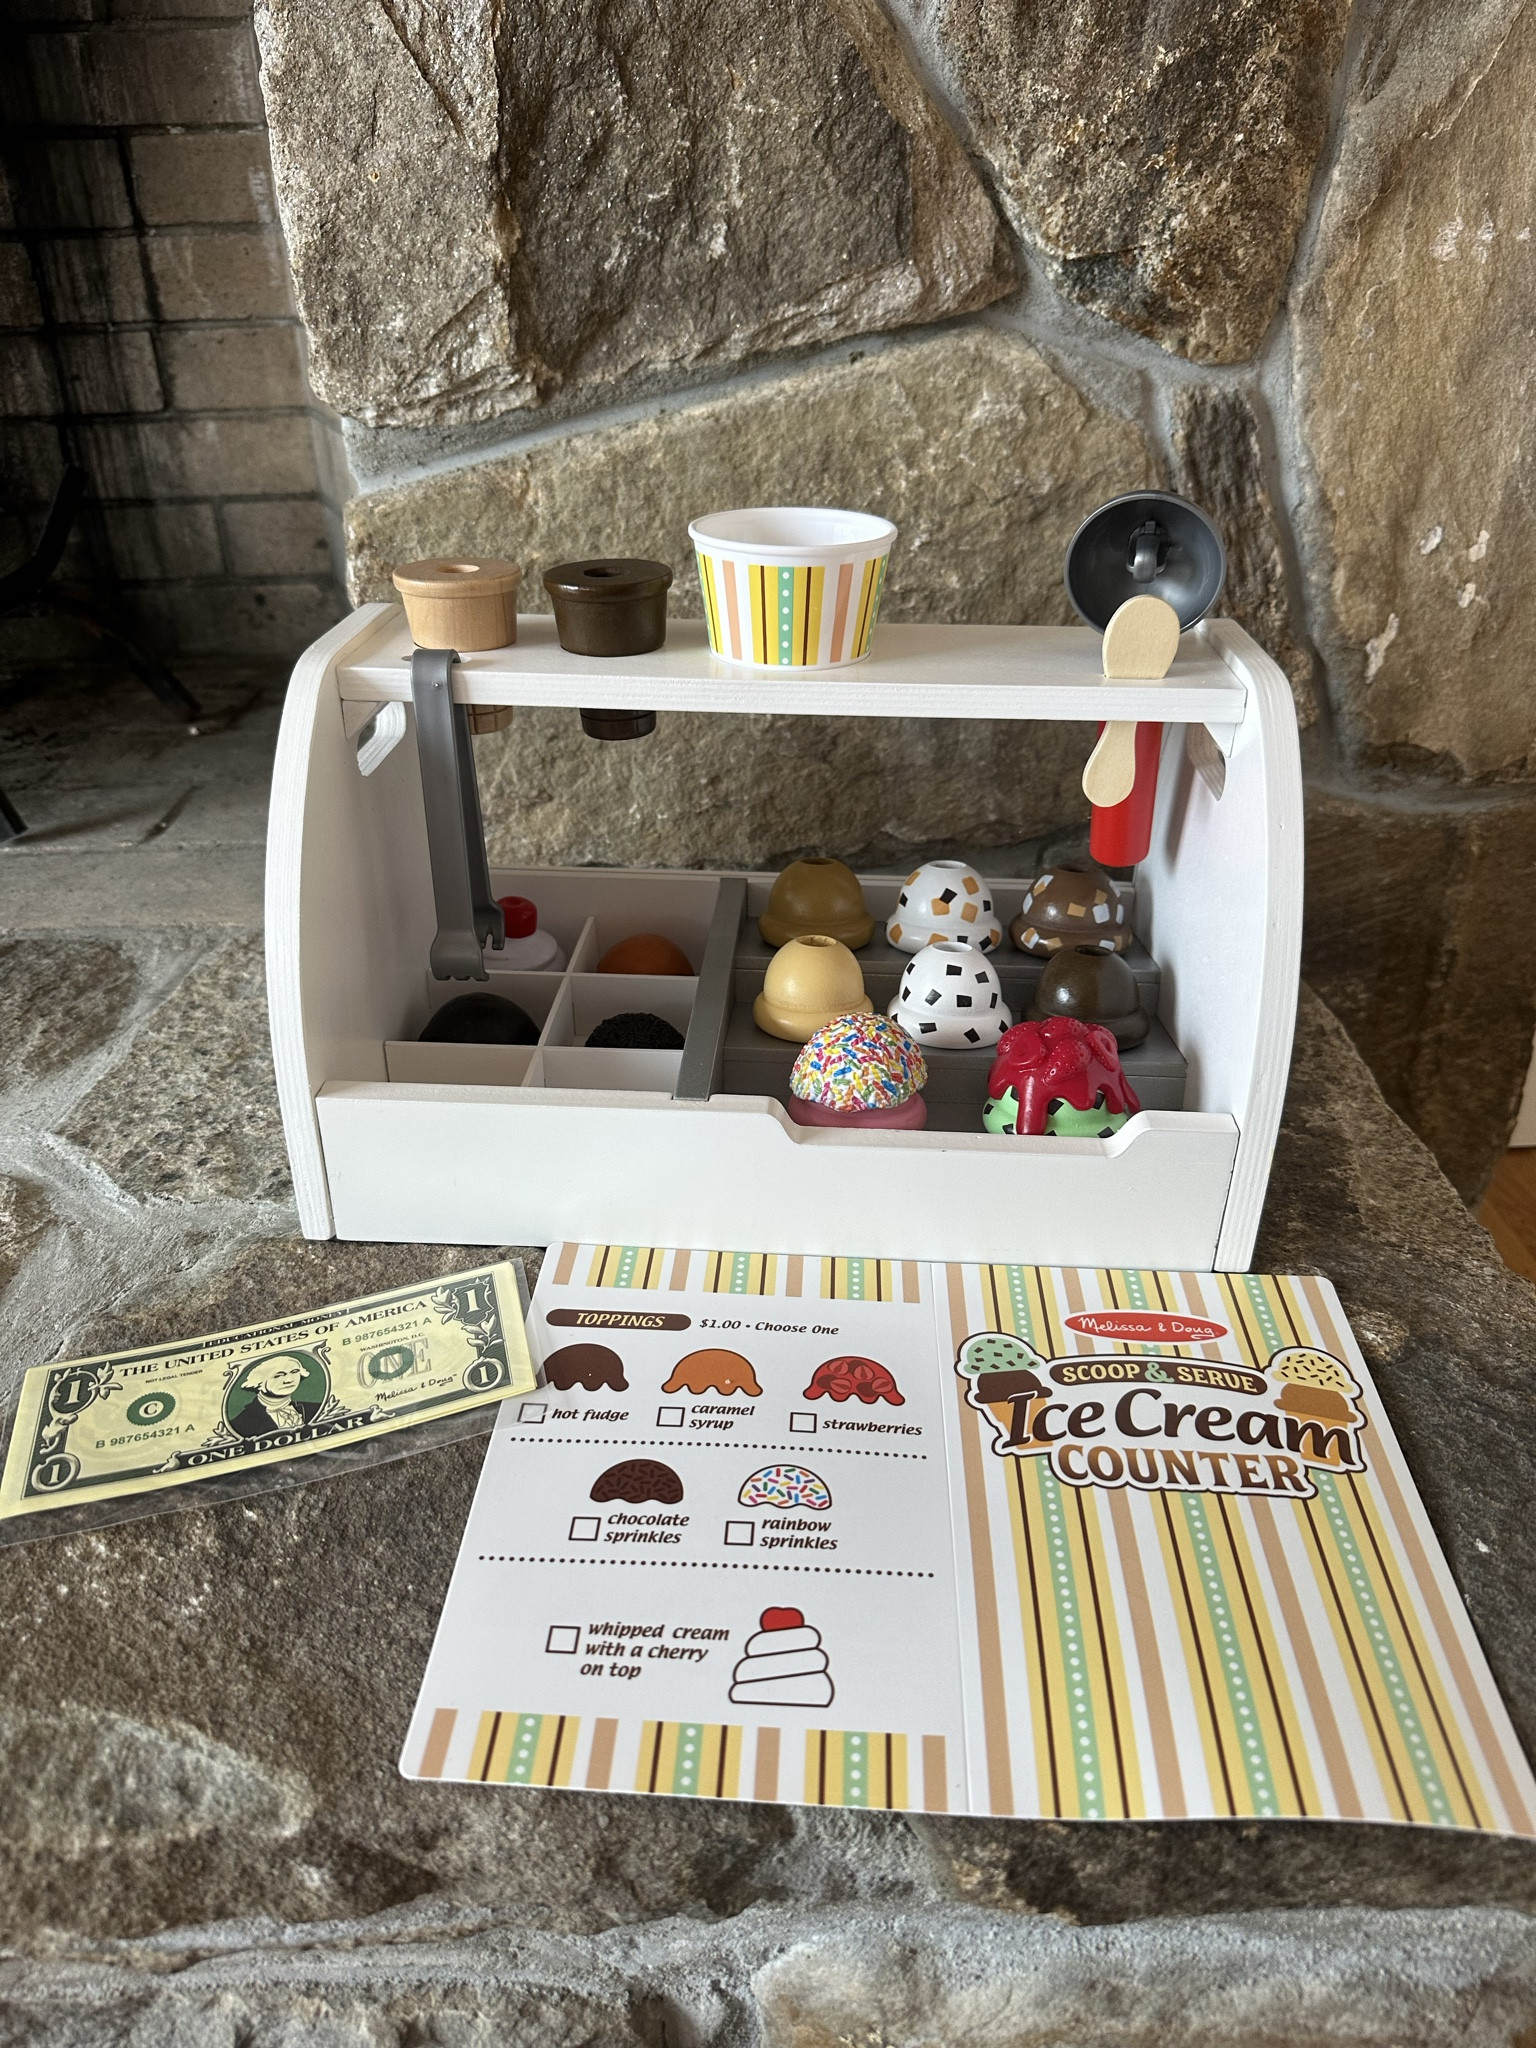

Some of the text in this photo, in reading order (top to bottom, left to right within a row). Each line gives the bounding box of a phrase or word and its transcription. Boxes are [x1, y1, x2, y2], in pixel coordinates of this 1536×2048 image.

[465, 1290, 480, 1313] 1
[209, 1310, 343, 1346] EDUCATIONAL MONEY
[576, 1312, 666, 1328] TOPPINGS
[699, 1318, 839, 1335] $1.00 Choose One
[1078, 1317, 1215, 1340] Melissa & Doug
[120, 1300, 428, 1377] THE UNITED STATES OF AMERICA
[342, 1317, 432, 1346] B 987654321 A
[180, 1369, 203, 1378] TENDER
[479, 1366, 490, 1384] 1
[1062, 1362, 1258, 1393] SCOOP & SERVE
[64, 1379, 83, 1405] 1
[375, 1387, 418, 1401] Melissa
[144, 1402, 158, 1416] C
[551, 1408, 630, 1421] hot fudge
[691, 1404, 755, 1416] caramel
[689, 1418, 734, 1431] syrup
[822, 1418, 923, 1436] strawberries
[1002, 1388, 1356, 1467] Ice Cream
[96, 1424, 195, 1448] B 987654321 A
[188, 1416, 365, 1466] ONE DOLLAR
[50, 1464, 60, 1484] 1
[1058, 1443, 1307, 1492] COUNTER
[607, 1512, 690, 1527] chocolate
[761, 1517, 832, 1532] rainbow
[604, 1529, 682, 1544] sprinkles
[760, 1534, 838, 1550] sprinkles
[588, 1621, 730, 1641] whipped cream
[585, 1641, 708, 1663] with a cherry
[580, 1661, 642, 1680] on top
